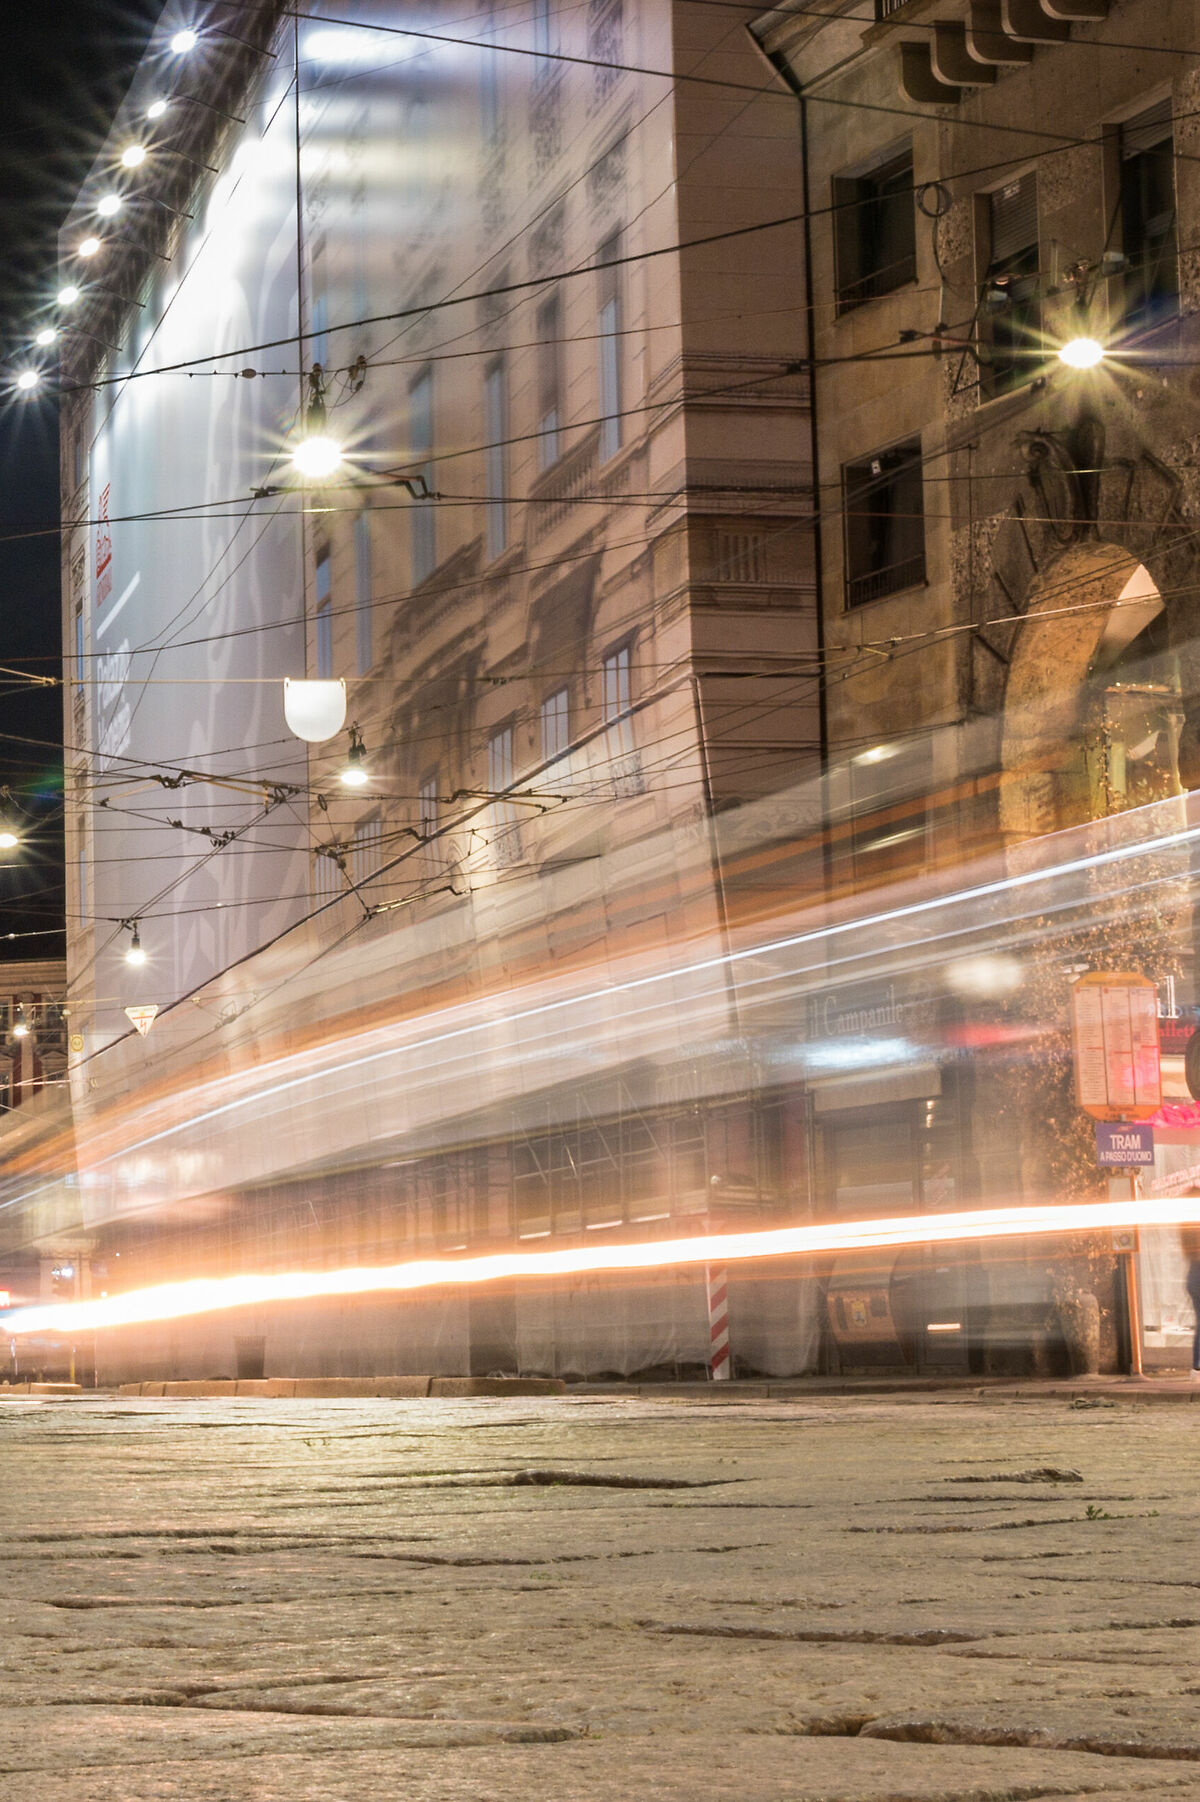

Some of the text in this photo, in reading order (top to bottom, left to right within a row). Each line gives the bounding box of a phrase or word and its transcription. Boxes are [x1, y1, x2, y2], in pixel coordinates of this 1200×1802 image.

[823, 983, 904, 1036] Campanile
[1109, 1134, 1142, 1150] TRAM
[1105, 1151, 1127, 1162] PASSO
[1127, 1151, 1153, 1162] D'UOMO
